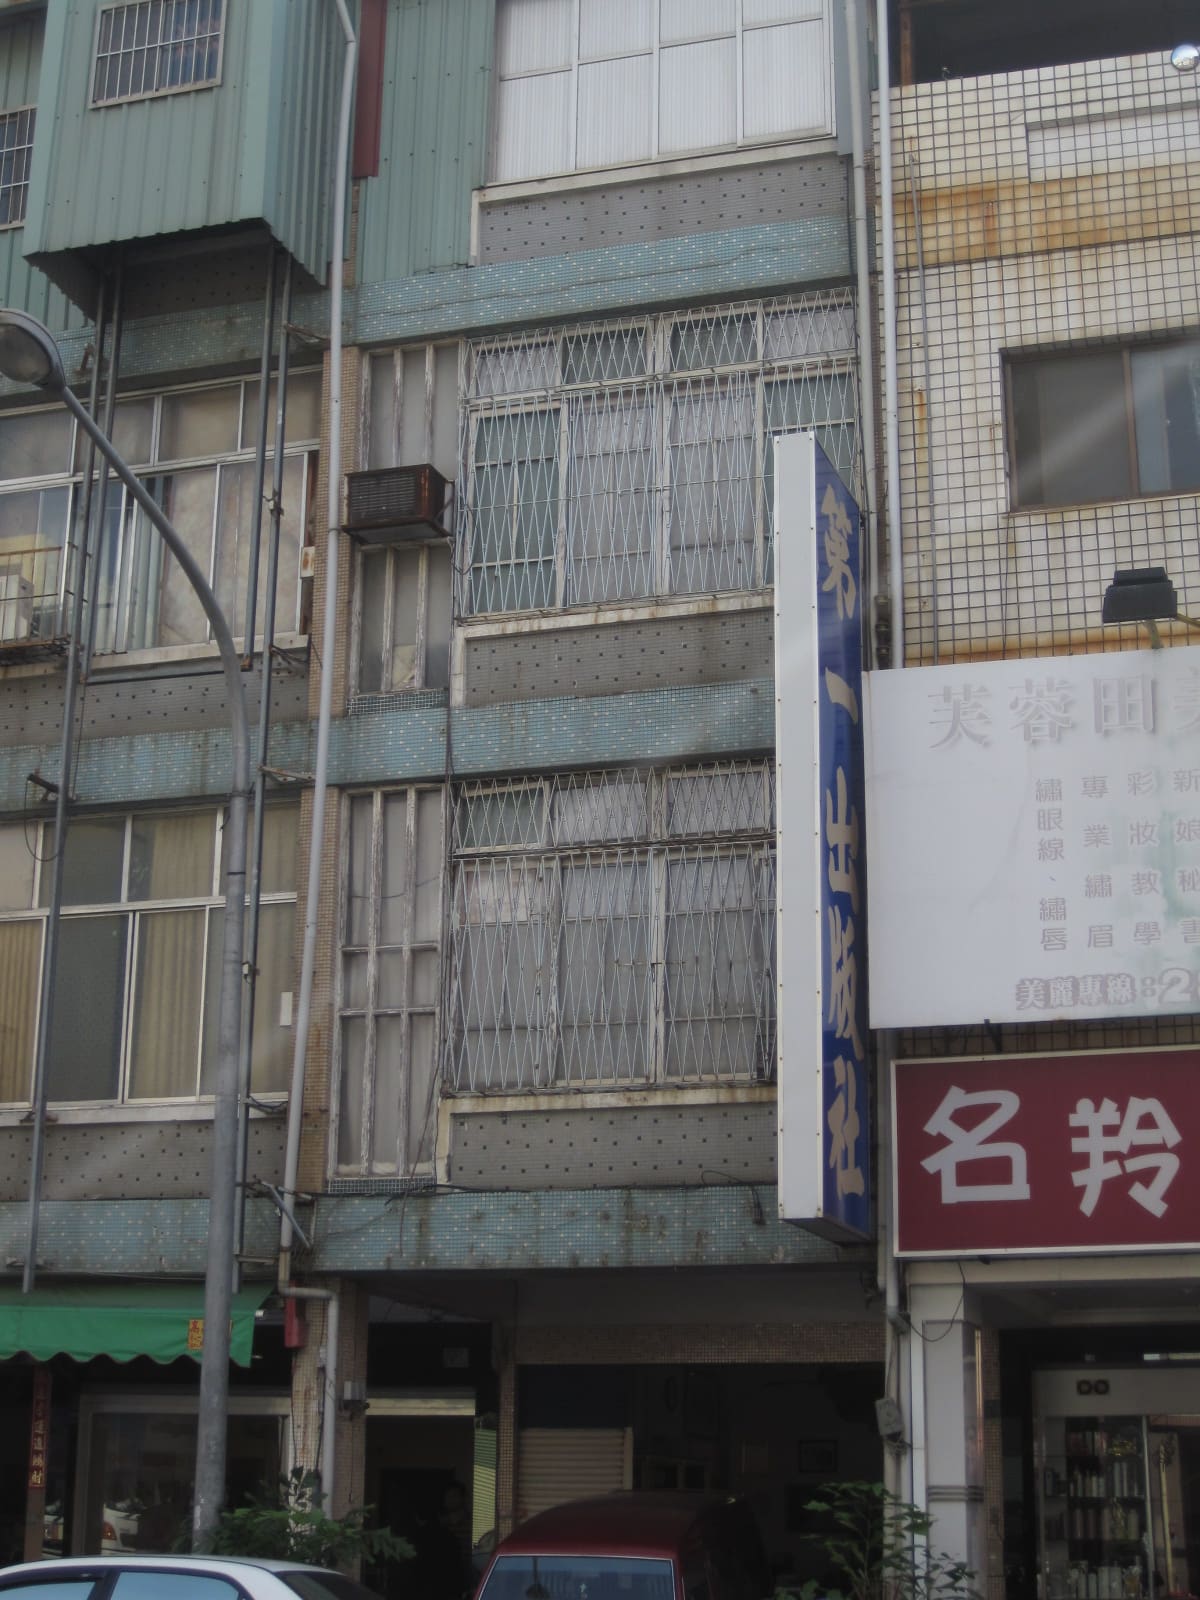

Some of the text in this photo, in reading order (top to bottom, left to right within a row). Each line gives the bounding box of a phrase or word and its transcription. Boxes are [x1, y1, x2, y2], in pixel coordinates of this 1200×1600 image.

[1081, 774, 1114, 949] 專業繡眉
[1127, 770, 1161, 946] 彩妝教學
[920, 1085, 1182, 1218] 名羚
